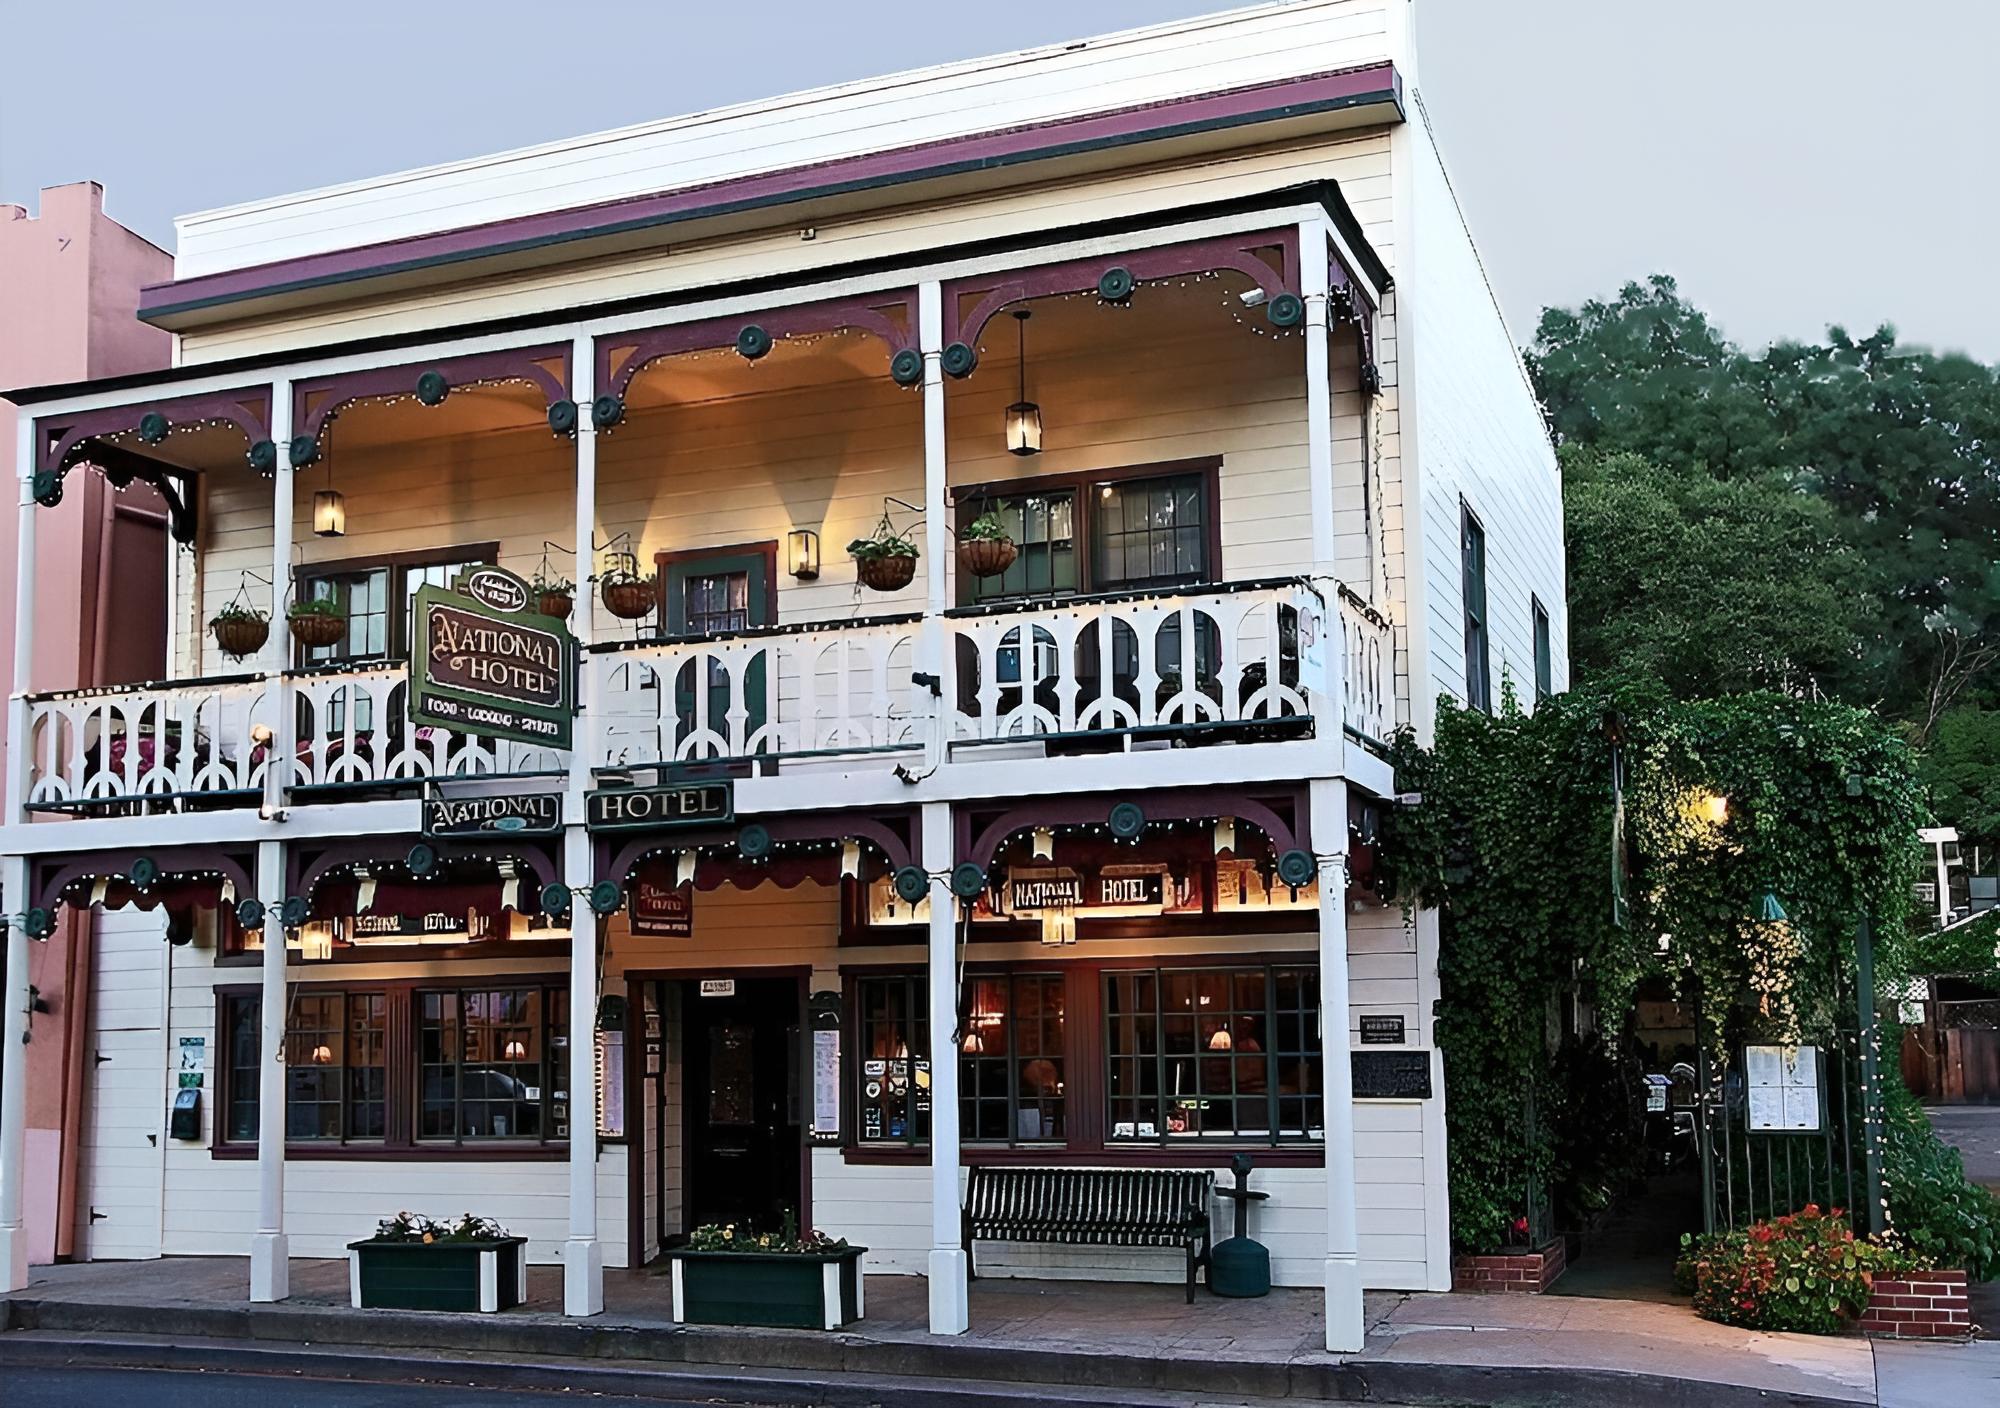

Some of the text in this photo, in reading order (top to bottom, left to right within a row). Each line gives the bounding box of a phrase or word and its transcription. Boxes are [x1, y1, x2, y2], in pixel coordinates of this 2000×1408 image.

[432, 613, 558, 672] NATIONAL
[451, 656, 553, 694] HOTEL
[433, 790, 720, 827] NATIONAL HOTEL
[1102, 879, 1148, 903] HOTEL
